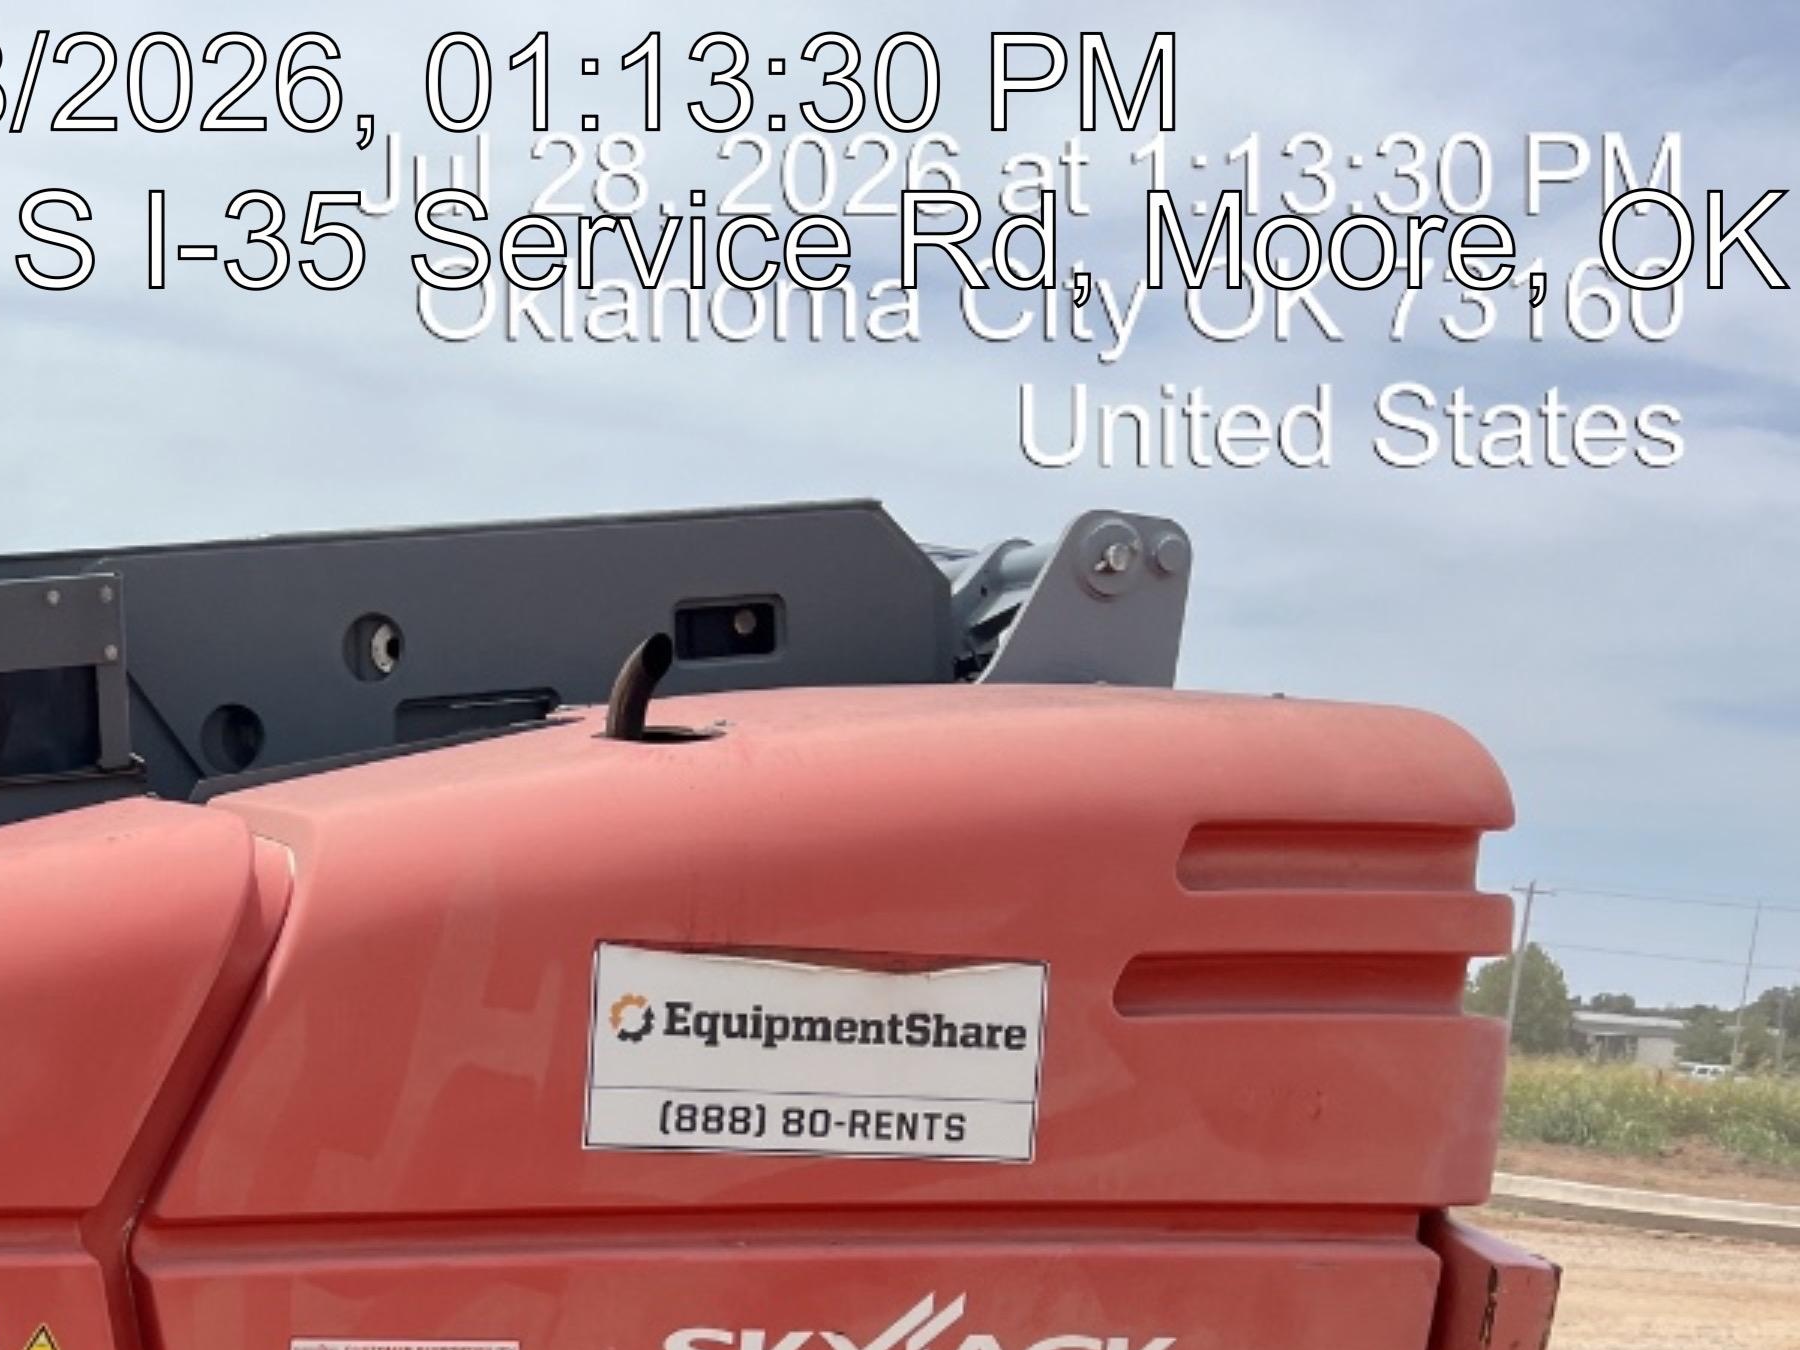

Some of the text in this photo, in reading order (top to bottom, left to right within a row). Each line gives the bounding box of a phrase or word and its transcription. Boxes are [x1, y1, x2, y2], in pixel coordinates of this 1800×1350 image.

[663, 1001, 1028, 1051] EquipmentShare
[659, 1100, 967, 1142] (888) 80-RENTS
